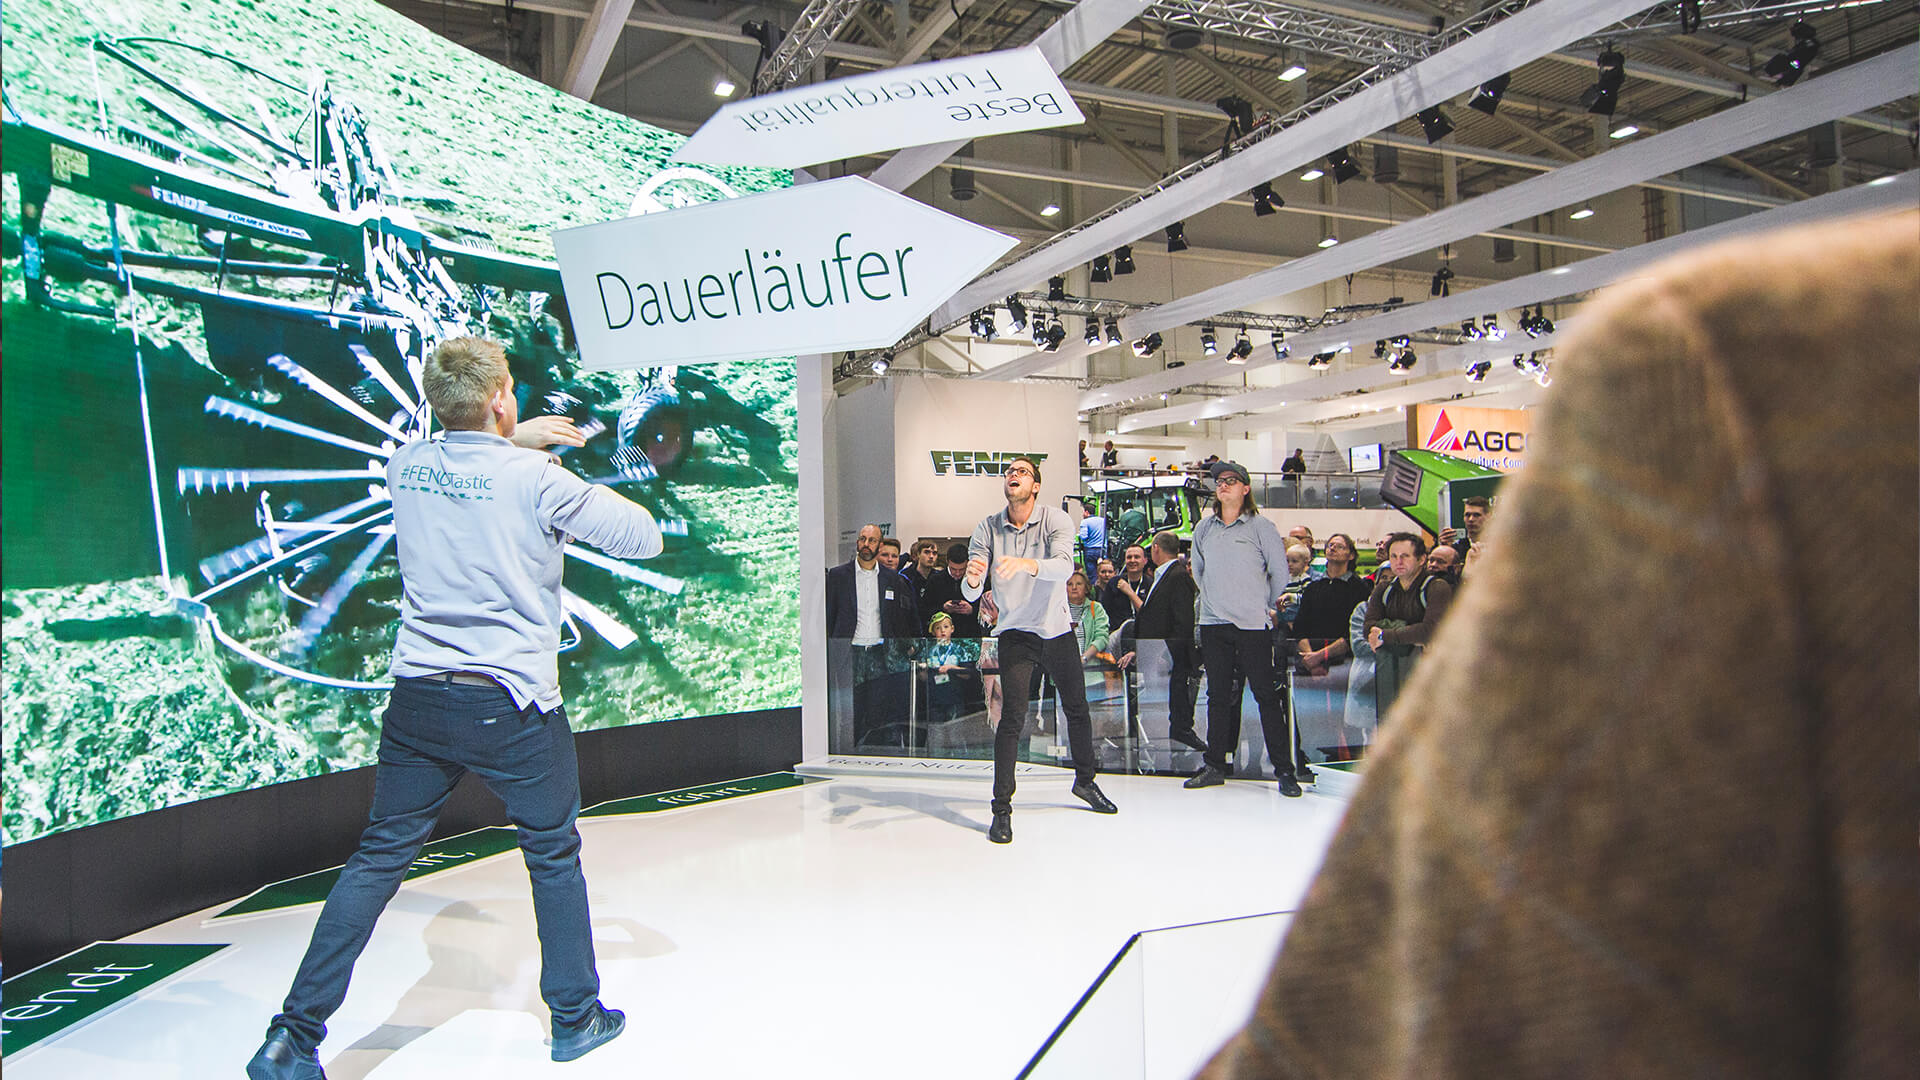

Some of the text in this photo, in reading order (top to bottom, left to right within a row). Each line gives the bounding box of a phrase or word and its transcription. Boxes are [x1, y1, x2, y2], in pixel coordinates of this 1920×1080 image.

[736, 67, 1004, 133] Futterqualität
[949, 91, 1063, 123] Beste
[151, 184, 208, 212] FENDT
[595, 232, 914, 331] Dauerläufer
[1463, 429, 1528, 452] AGC
[400, 464, 494, 490] #FENDTastic
[656, 786, 758, 805] führt.
